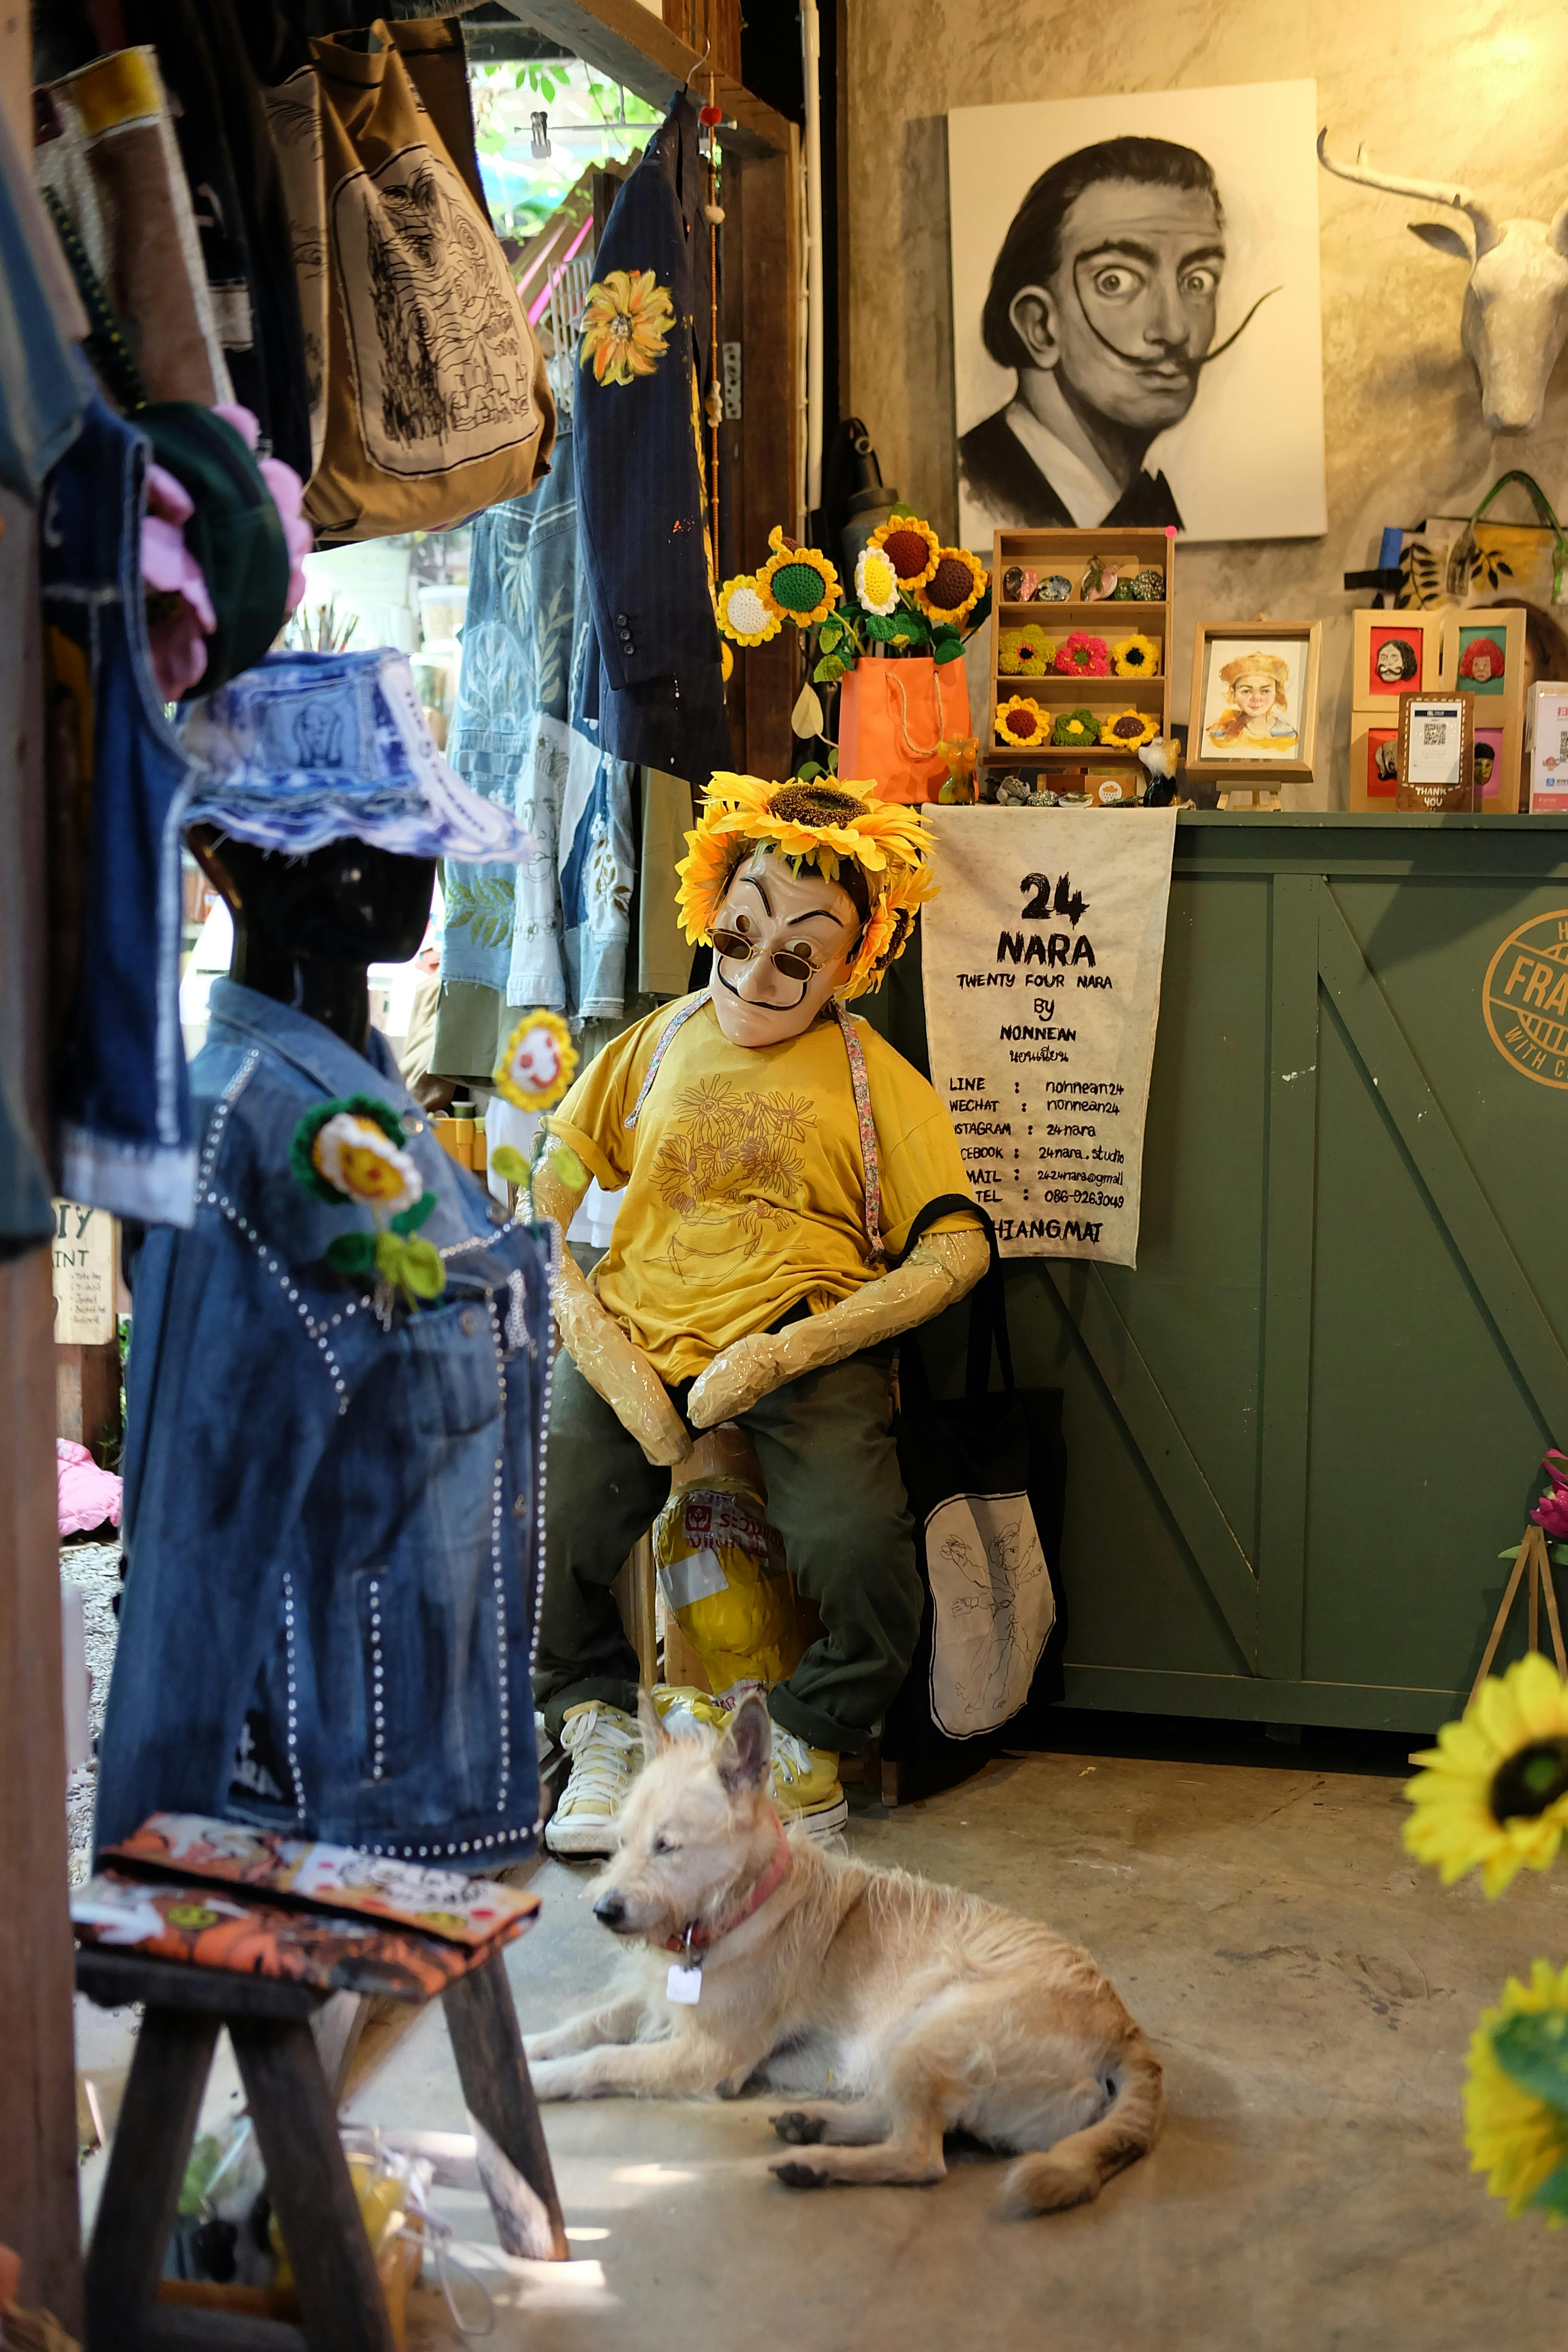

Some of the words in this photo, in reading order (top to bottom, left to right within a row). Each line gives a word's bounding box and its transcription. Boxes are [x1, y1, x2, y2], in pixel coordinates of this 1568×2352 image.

[1415, 787, 1447, 796] THANK
[1424, 797, 1443, 807] YOU
[1020, 871, 1090, 930] 24
[997, 931, 1096, 968] NARA
[956, 973, 1016, 989] TWENTY
[1025, 974, 1065, 988] FOUR
[1077, 975, 1113, 990] NARA
[1504, 955, 1568, 1017] FRA
[1000, 1025, 1076, 1041] NONNEAN
[1504, 1026, 1547, 1070] WITH
[1555, 1059, 1568, 1079] C
[950, 1077, 985, 1091] LINE
[1046, 1080, 1124, 1096] nonnean24
[949, 1098, 1000, 1113] WECHAT
[1047, 1099, 1120, 1115] nonnean24
[1046, 1124, 1096, 1137] 24nara
[975, 1189, 1003, 1202] TEL
